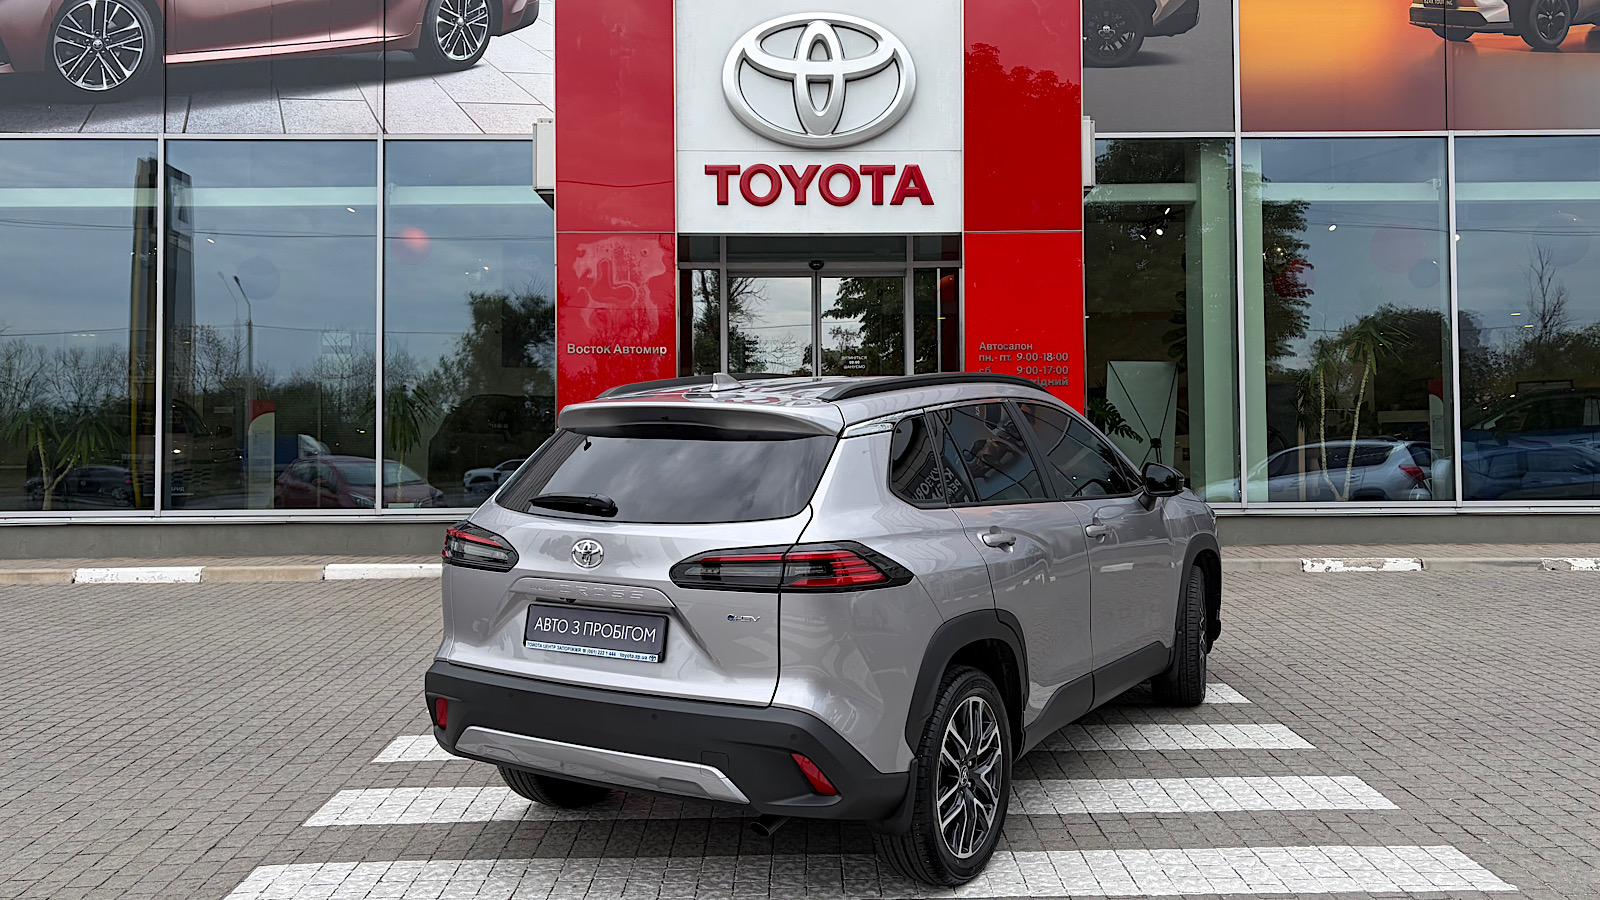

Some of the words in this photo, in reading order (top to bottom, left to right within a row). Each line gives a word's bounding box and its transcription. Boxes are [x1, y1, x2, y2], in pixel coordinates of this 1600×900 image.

[704, 163, 935, 206] TOYOTA
[567, 343, 611, 355] Восток
[613, 343, 668, 357] Автомир
[979, 341, 1033, 351] Автосалон
[1016, 365, 1069, 375] 9:00-17:00
[559, 584, 644, 599] CROSS
[534, 617, 569, 634] АВТО
[571, 620, 580, 635] З
[583, 621, 656, 643] ПРОБІГОМ
